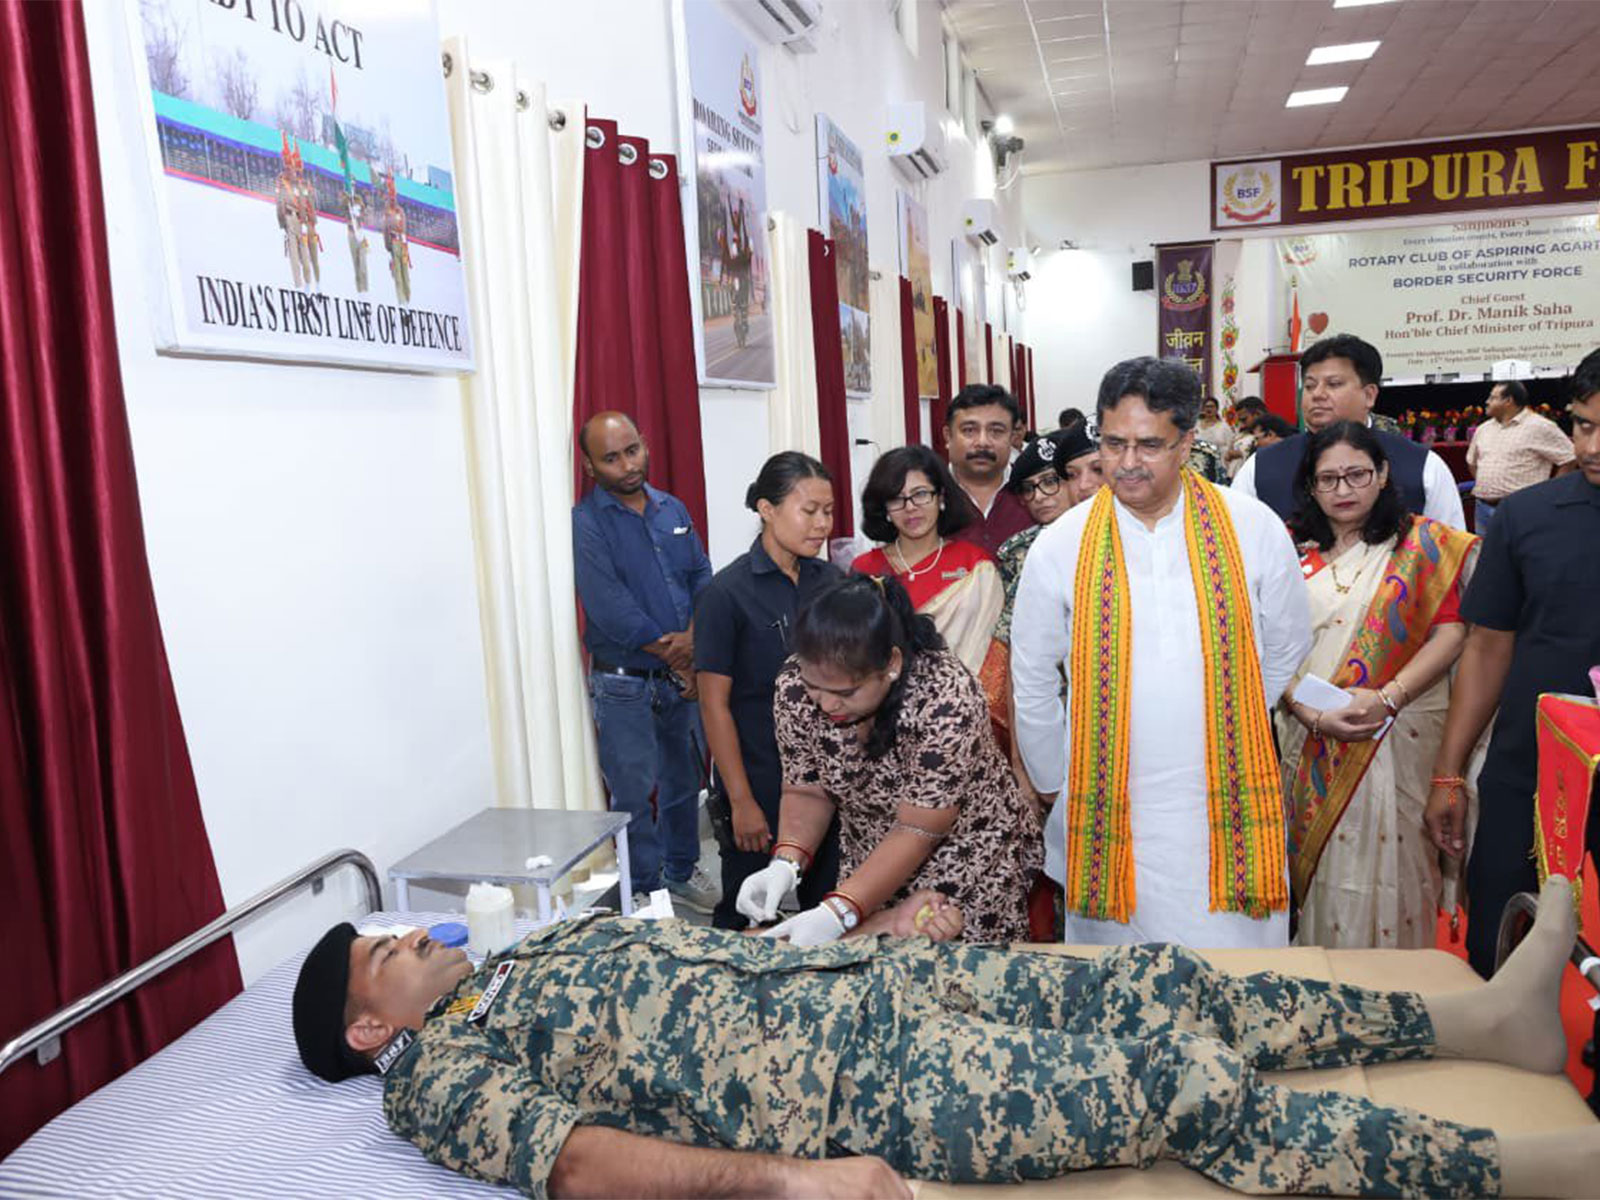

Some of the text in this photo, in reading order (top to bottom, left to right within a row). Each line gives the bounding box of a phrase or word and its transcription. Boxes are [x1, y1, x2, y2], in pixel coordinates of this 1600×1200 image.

[314, 12, 364, 70] ACT
[1292, 146, 1544, 213] TRIPURA
[1236, 186, 1261, 200] BSF
[1348, 253, 1406, 269] ROTARY
[1409, 251, 1449, 264] CLUB
[1452, 249, 1473, 260] OF
[1475, 242, 1547, 259] ASPIRING
[1393, 265, 1583, 289] BORDER SECURITY FORCE
[1460, 292, 1526, 306] Chief Guest
[196, 275, 463, 352] INDIA'S FIRST LINE OF DEFENCE
[1406, 302, 1573, 325] Prof. Dr. Manik Saha
[1165, 327, 1205, 350] जीवन
[1436, 325, 1469, 337] Chief
[1472, 322, 1526, 335] Minister
[1528, 320, 1542, 331] of
[1545, 318, 1594, 331] Tripura
